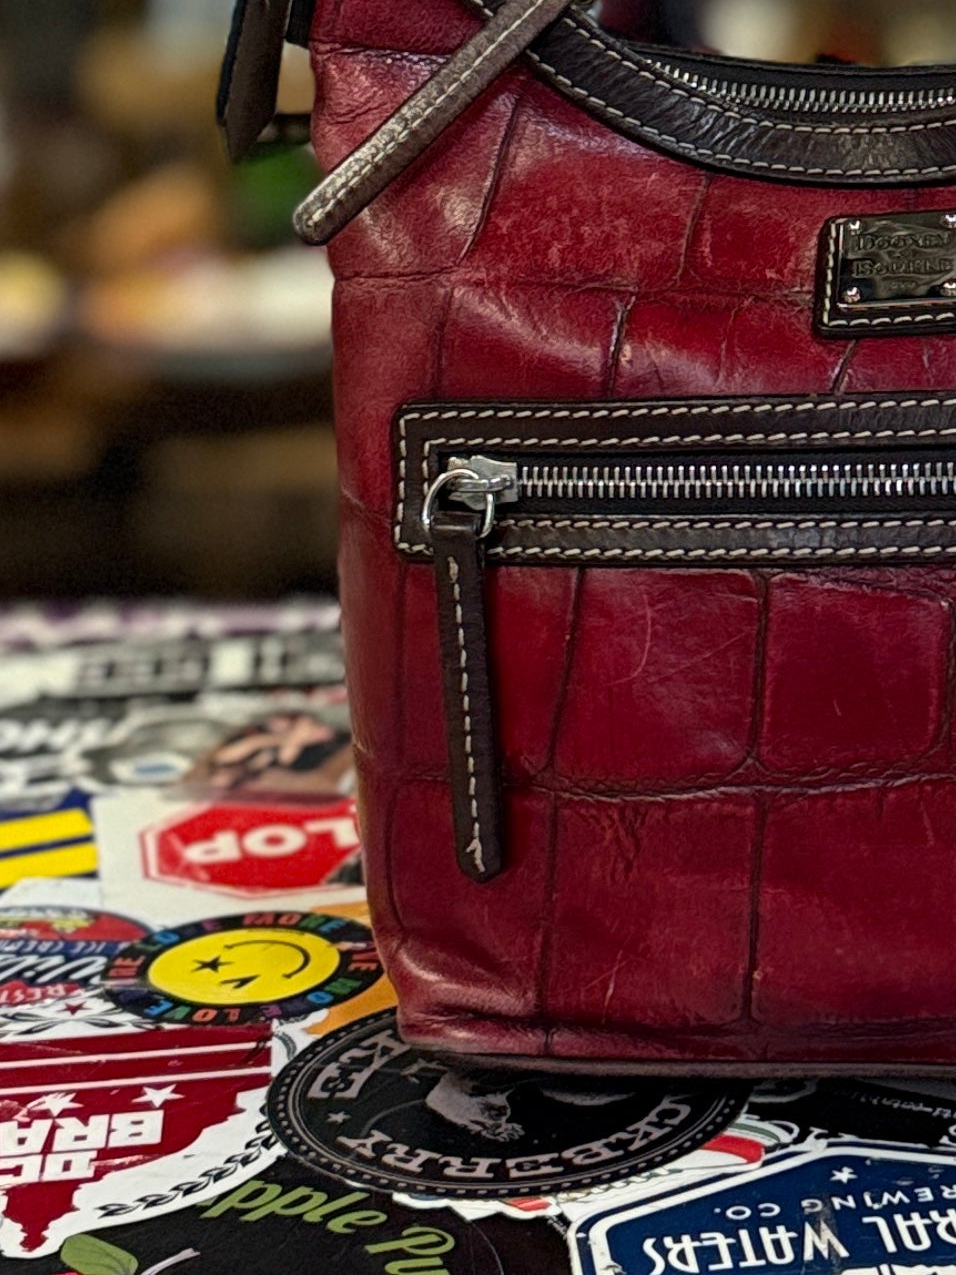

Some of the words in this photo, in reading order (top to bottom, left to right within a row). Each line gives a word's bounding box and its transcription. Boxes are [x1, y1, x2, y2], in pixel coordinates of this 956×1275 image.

[145, 998, 240, 1022] LOVE
[199, 1179, 388, 1234] pple
[712, 1203, 782, 1222] CO.
[642, 1218, 851, 1275] WATERS
